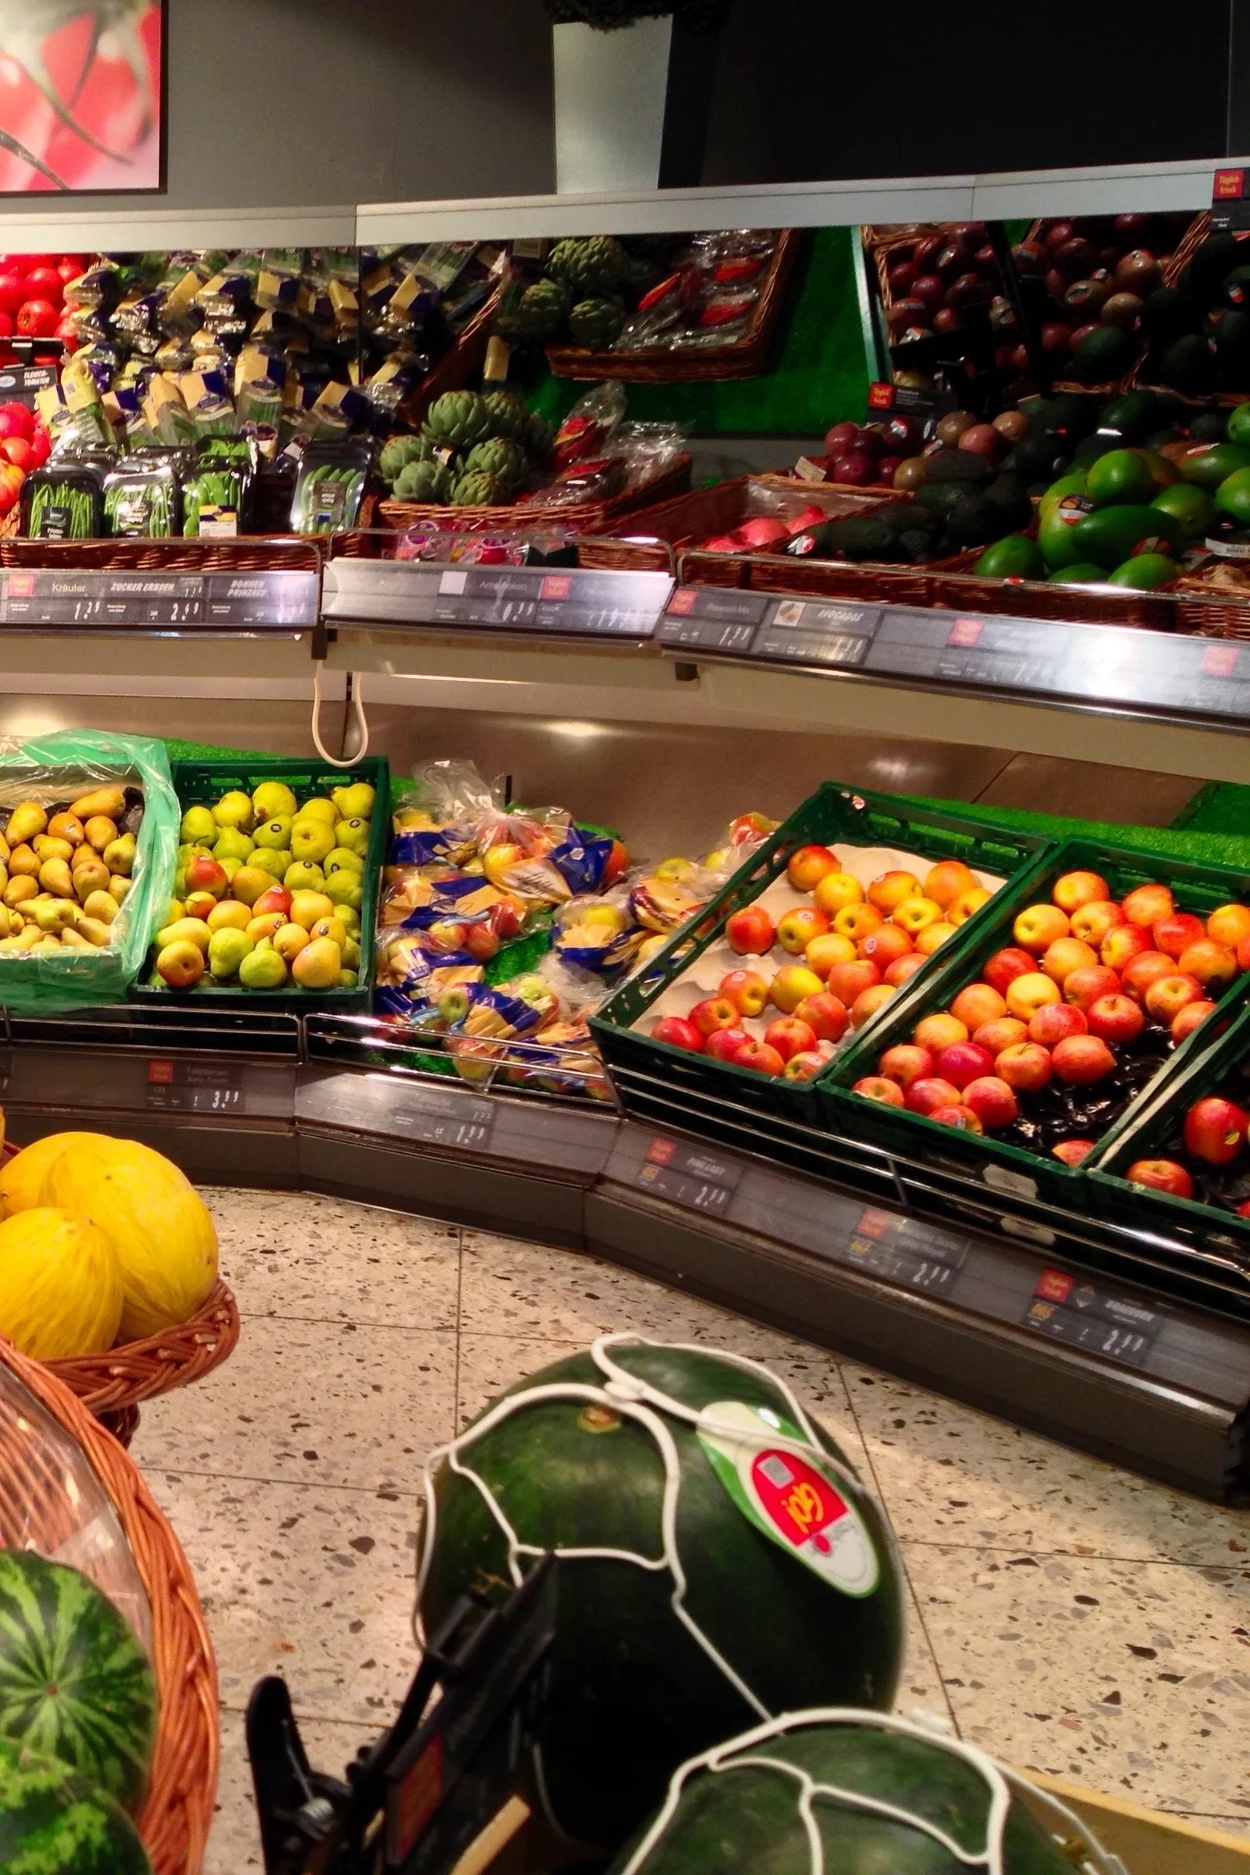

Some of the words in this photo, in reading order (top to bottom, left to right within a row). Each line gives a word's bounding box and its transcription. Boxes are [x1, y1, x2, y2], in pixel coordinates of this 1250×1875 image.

[52, 583, 87, 594] Kräuter
[110, 582, 142, 593] ZUCKER
[817, 607, 865, 623] AVOCADOS
